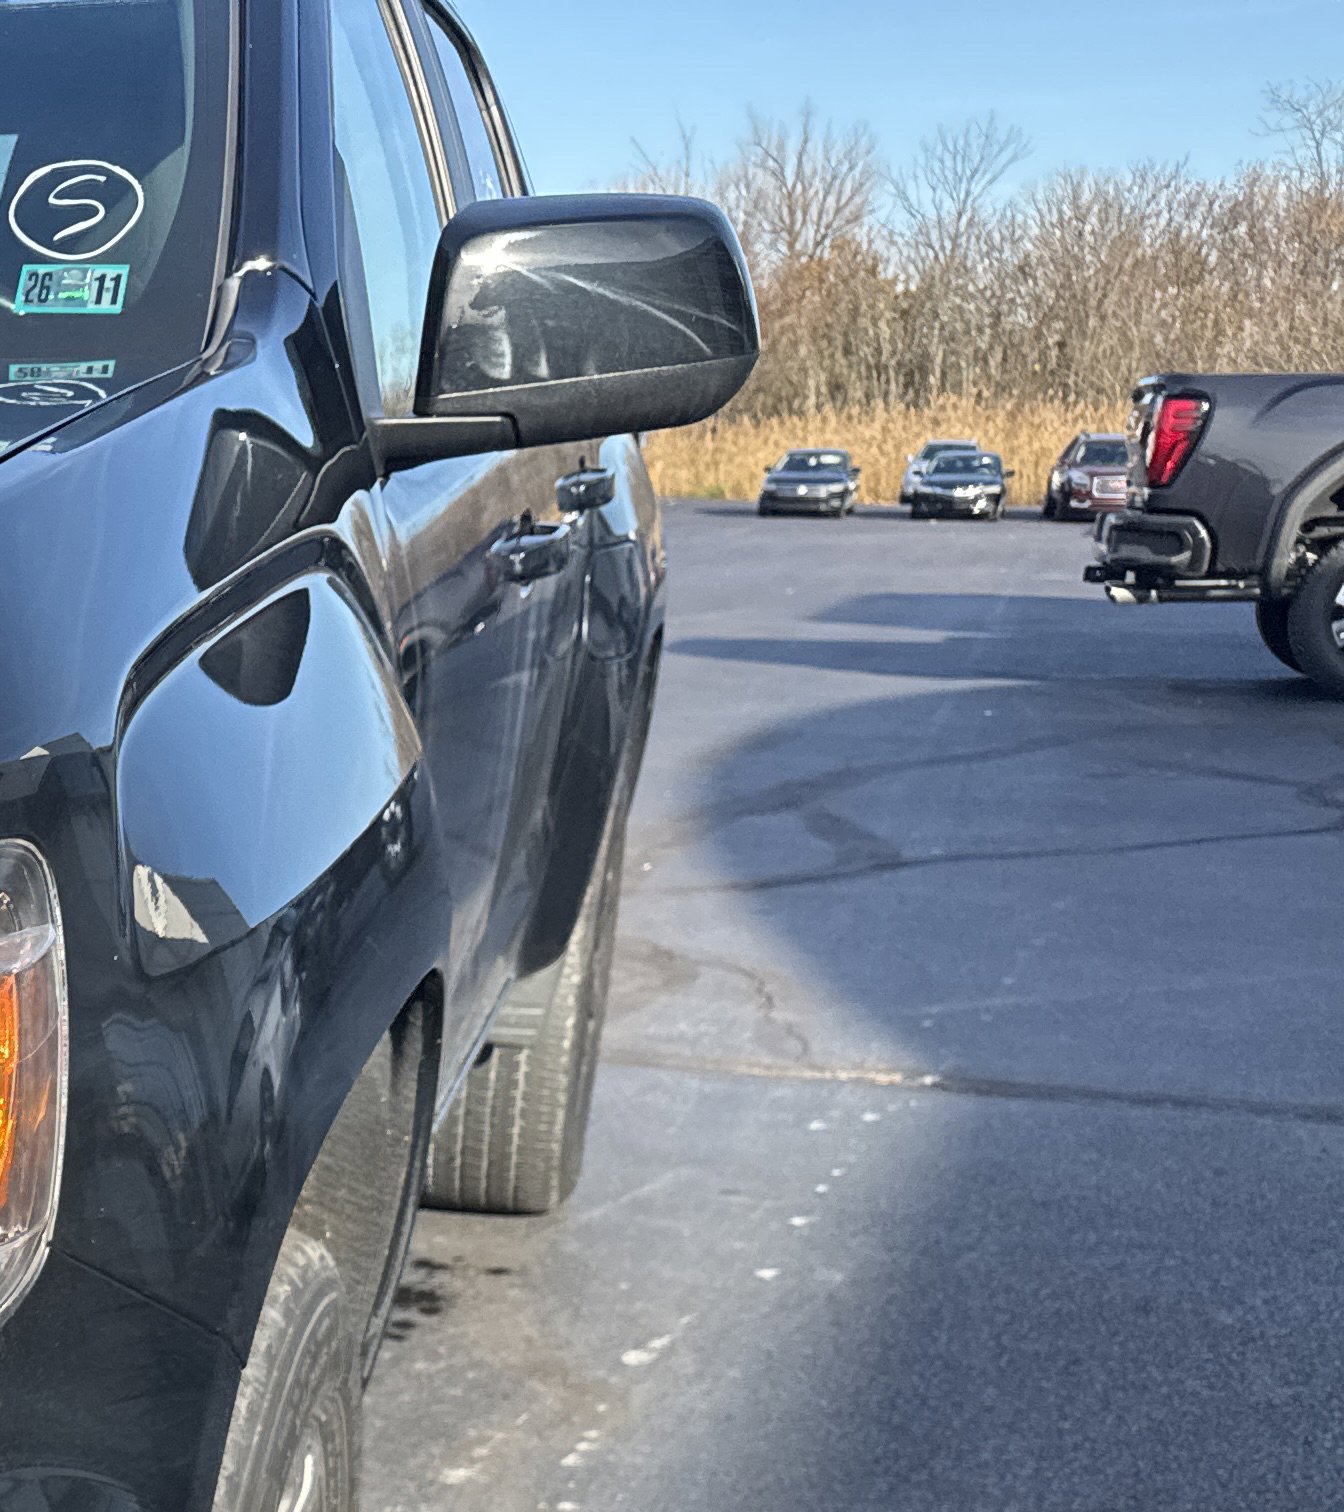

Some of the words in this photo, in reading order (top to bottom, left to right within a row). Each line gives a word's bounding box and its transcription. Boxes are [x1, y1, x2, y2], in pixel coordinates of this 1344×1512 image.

[48, 174, 107, 241] S
[24, 271, 53, 304] 26
[93, 272, 123, 306] 11
